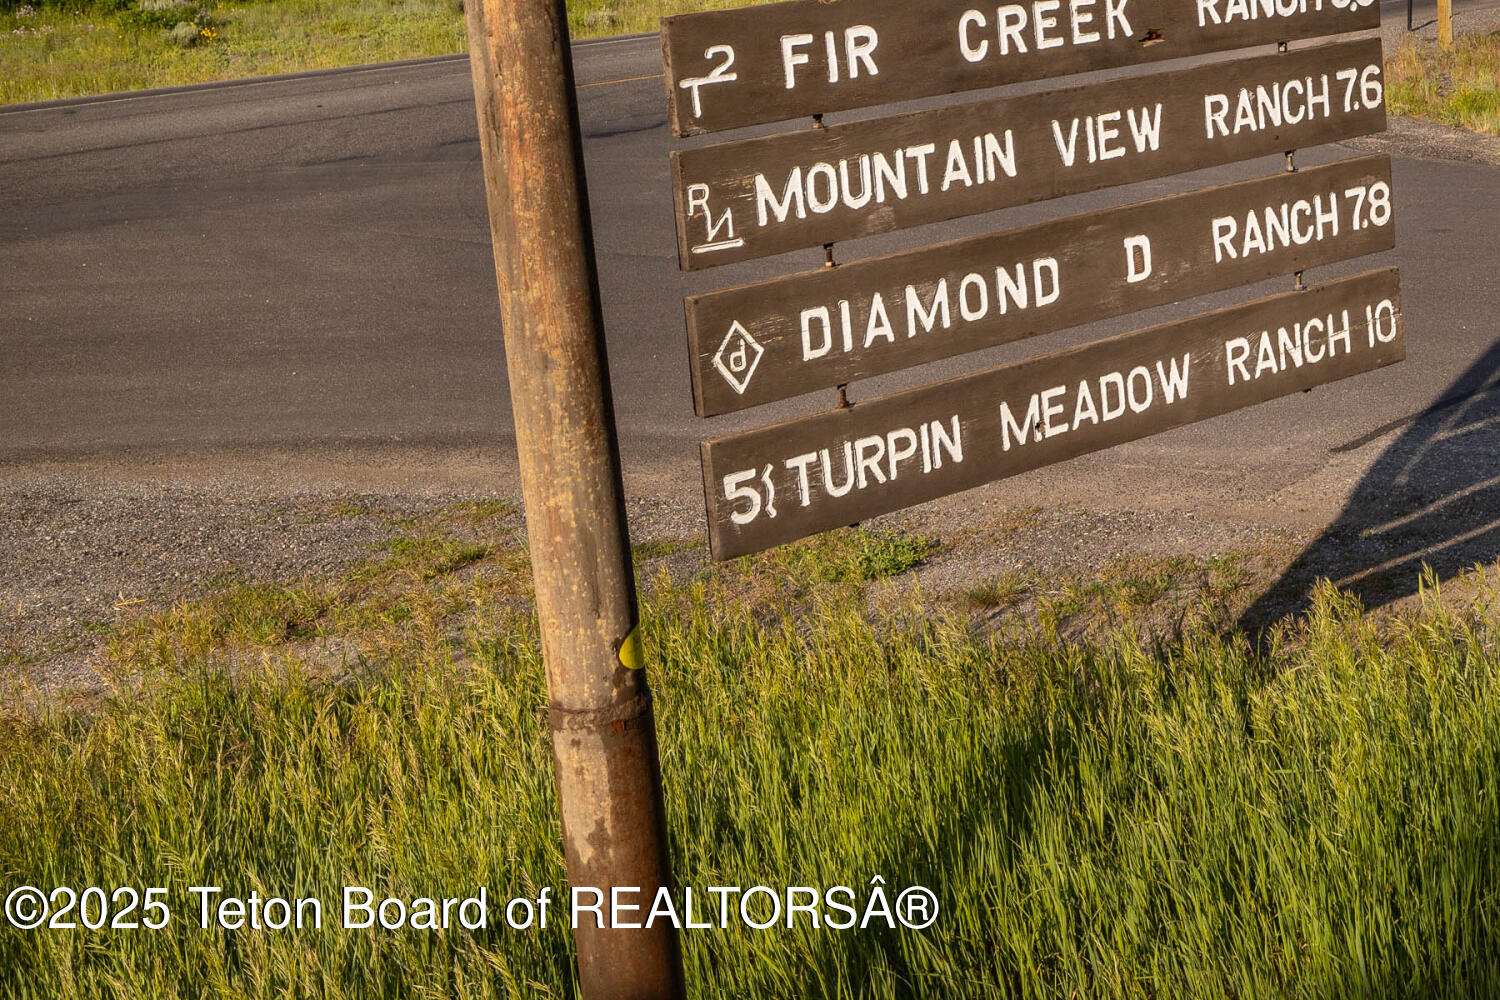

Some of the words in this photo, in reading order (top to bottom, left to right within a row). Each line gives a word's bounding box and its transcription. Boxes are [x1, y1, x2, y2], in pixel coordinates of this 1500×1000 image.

[779, 24, 879, 90] FIR
[754, 129, 1018, 227] MOUNTAIN
[1051, 103, 1163, 167] VIEW
[1204, 74, 1330, 139] RANCH
[1335, 64, 1383, 113] 7.6
[800, 256, 1060, 362] DIAMOND
[1123, 234, 1152, 284] D
[1211, 191, 1339, 264] RANCH
[1344, 180, 1392, 231] 7.8
[785, 414, 964, 511] TURPIN
[999, 352, 1191, 452] MEADOW
[1225, 309, 1351, 386] RANCH
[1365, 299, 1397, 348] 10
